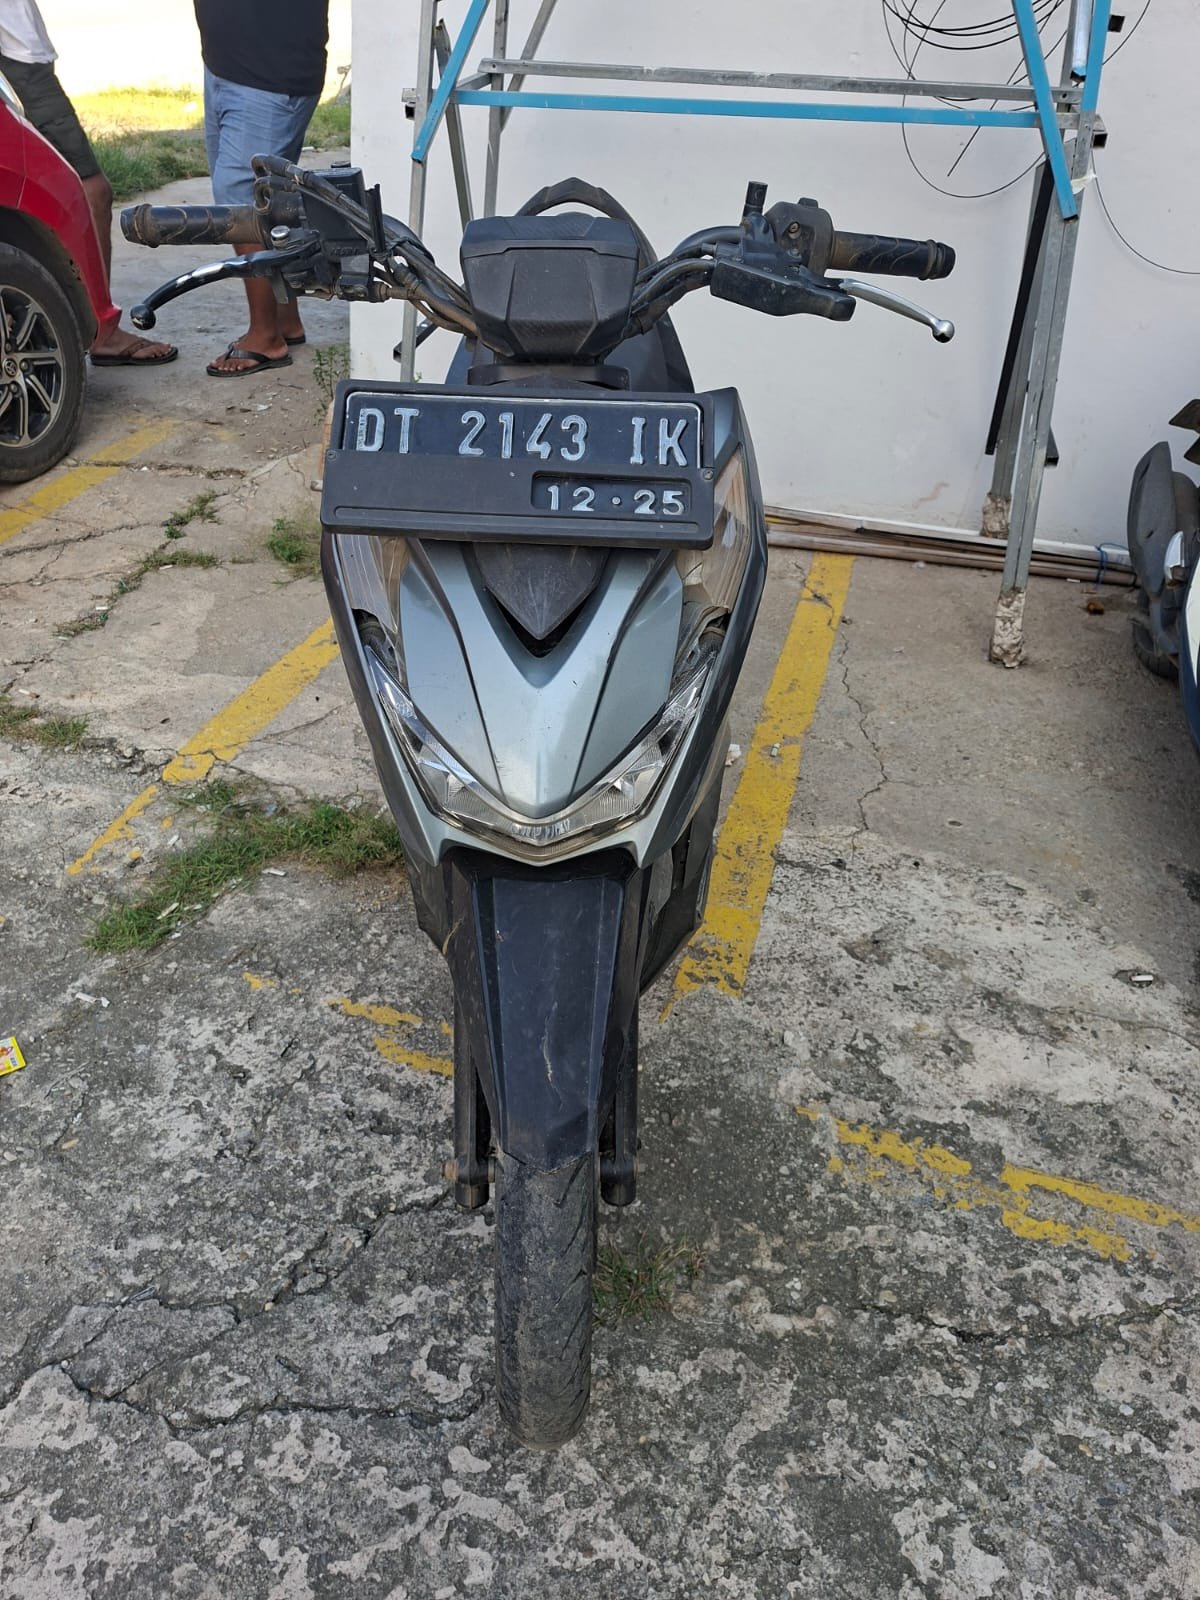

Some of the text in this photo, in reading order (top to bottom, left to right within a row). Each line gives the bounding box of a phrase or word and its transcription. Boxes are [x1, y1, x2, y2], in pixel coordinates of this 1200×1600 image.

[356, 407, 420, 454] DT
[458, 410, 588, 461] 2143
[630, 416, 688, 467] IK
